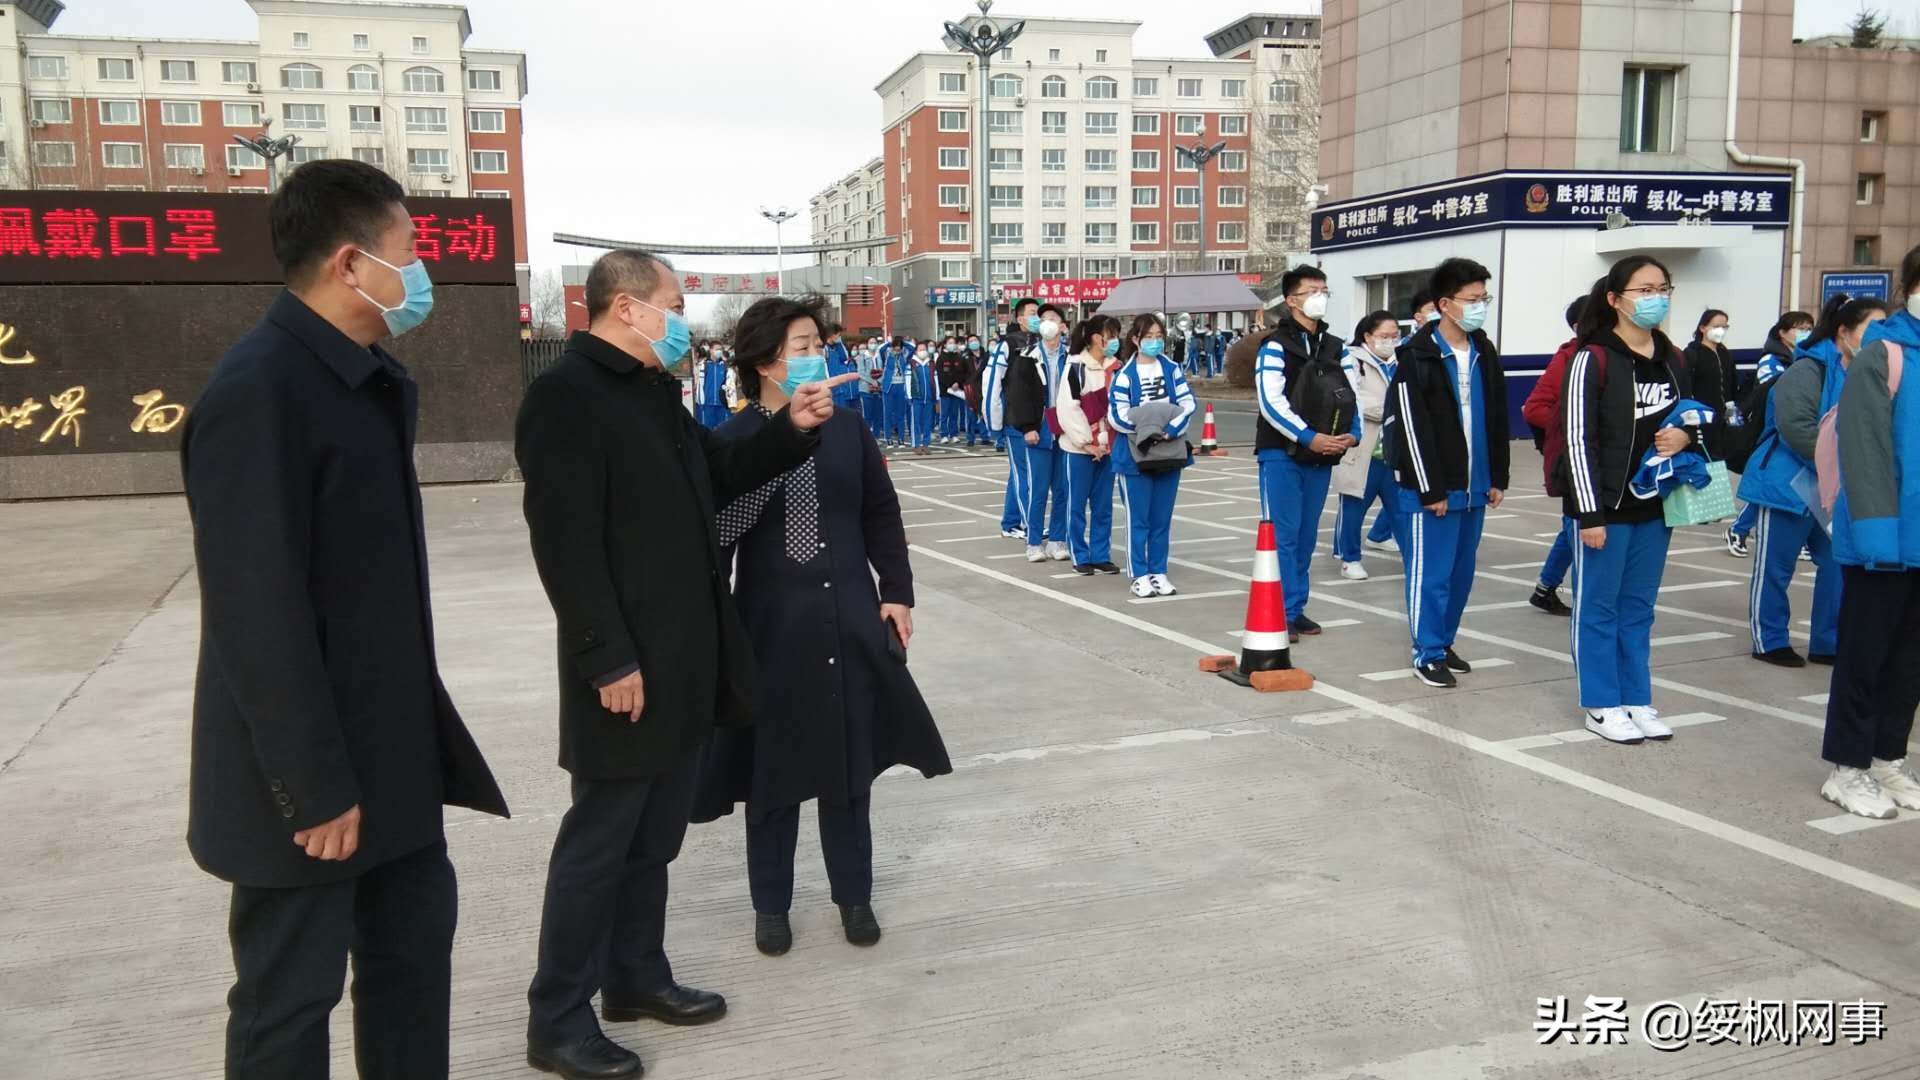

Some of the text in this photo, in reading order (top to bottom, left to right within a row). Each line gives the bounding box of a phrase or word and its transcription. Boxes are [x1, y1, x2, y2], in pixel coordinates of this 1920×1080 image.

[1338, 192, 1489, 229] 胜利派出所 绥化一中警务室
[1556, 184, 1774, 212] 胜利派出所 绥化一中警务室
[1571, 205, 1623, 215] POLICE
[0, 207, 222, 261] 佩戴口罩
[1346, 225, 1379, 238] POLICE
